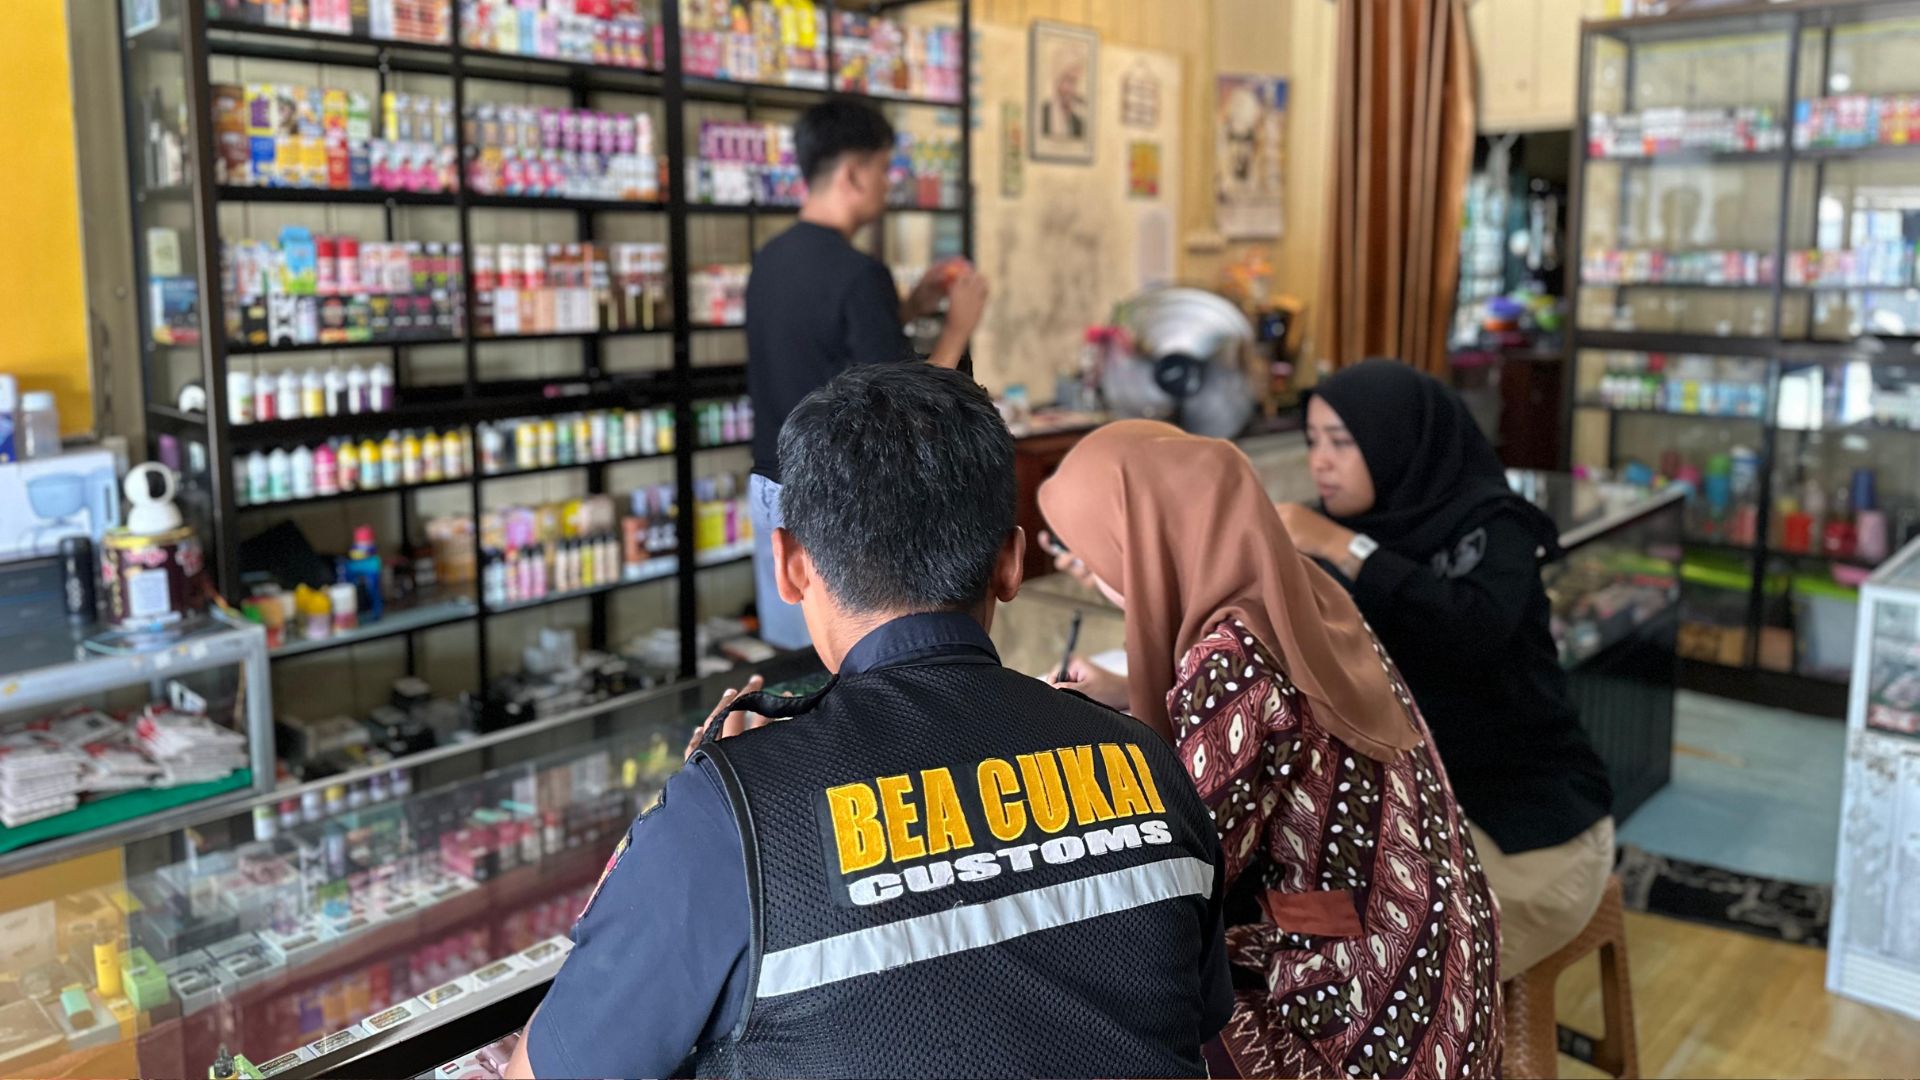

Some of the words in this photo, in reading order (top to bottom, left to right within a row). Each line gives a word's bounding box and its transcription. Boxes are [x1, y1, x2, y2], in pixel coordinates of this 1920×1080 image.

[826, 767, 974, 875] BEA
[977, 743, 1166, 842] CUKAI
[848, 819, 1173, 906] CUSTOMS
